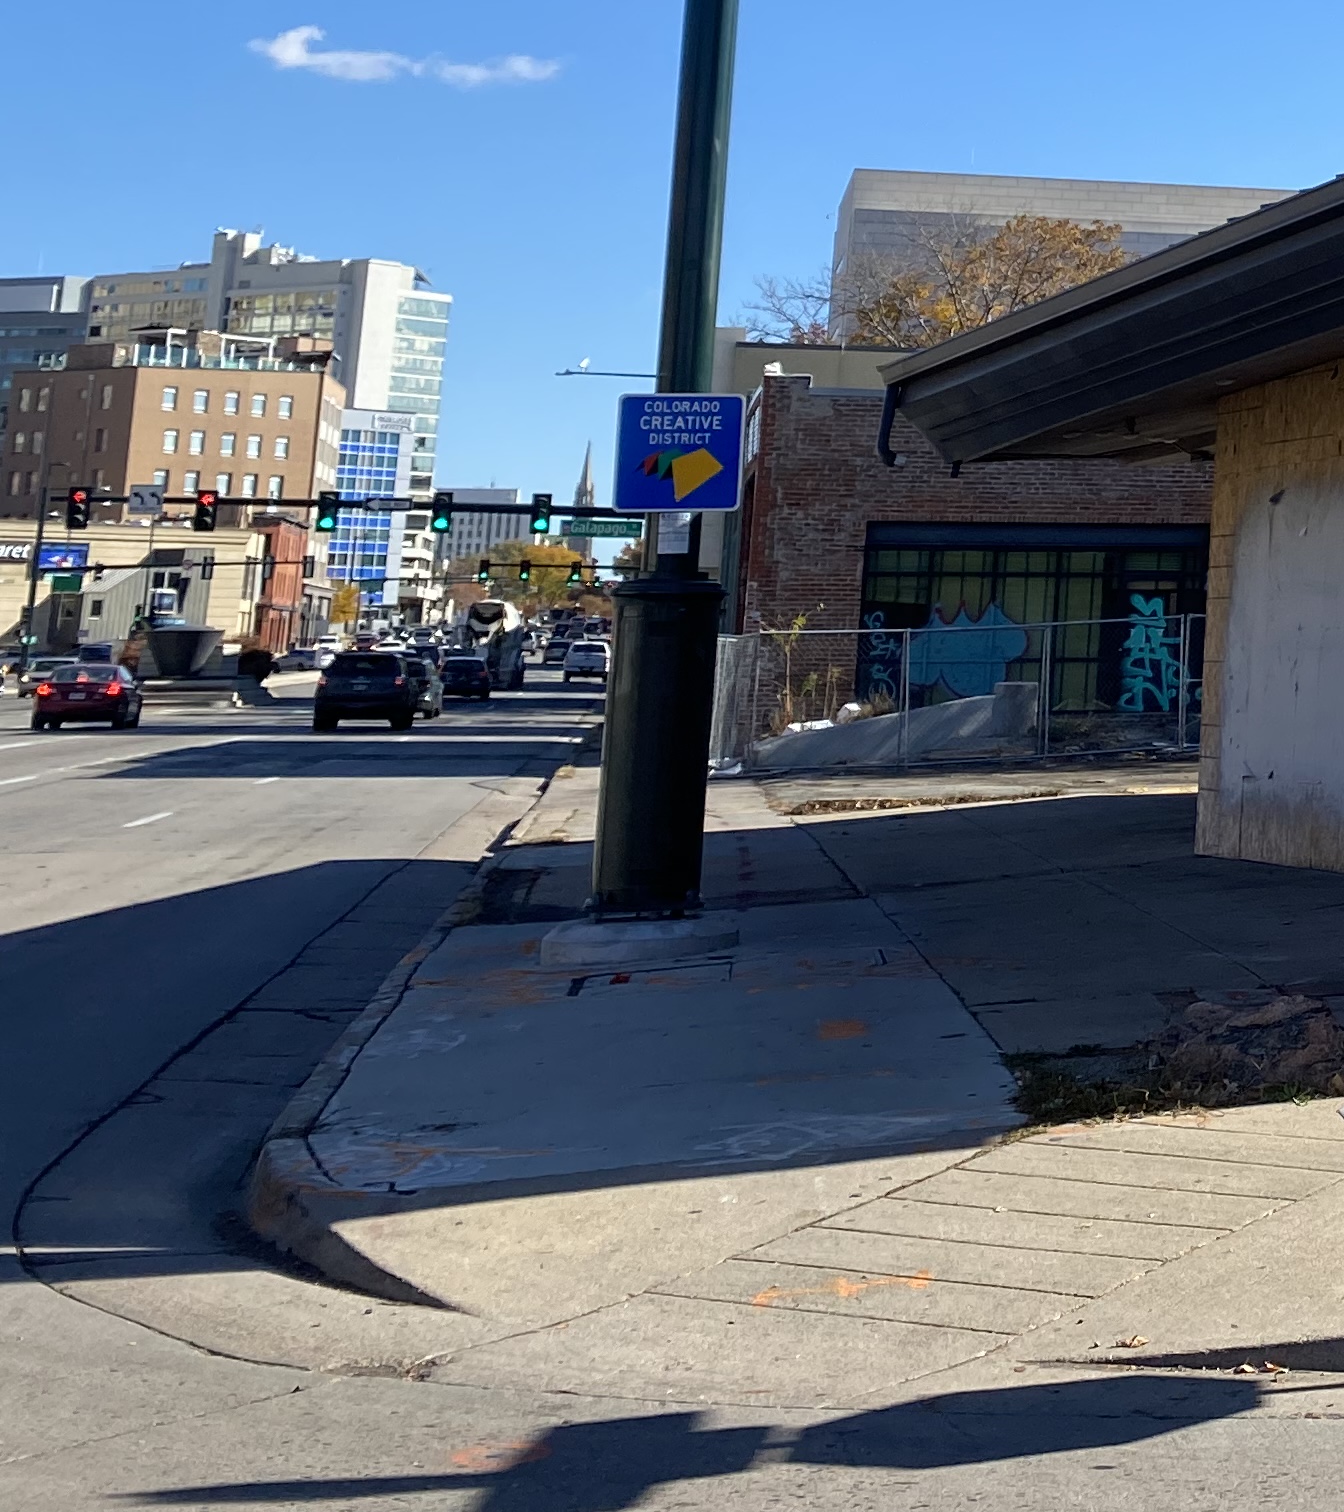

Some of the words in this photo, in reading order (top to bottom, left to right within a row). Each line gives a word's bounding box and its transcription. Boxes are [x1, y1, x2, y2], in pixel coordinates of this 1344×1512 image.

[644, 401, 721, 413] COLORADO
[640, 415, 722, 430] CREATIVE
[649, 433, 711, 445] DISTRICT
[570, 521, 627, 537] Galapago
